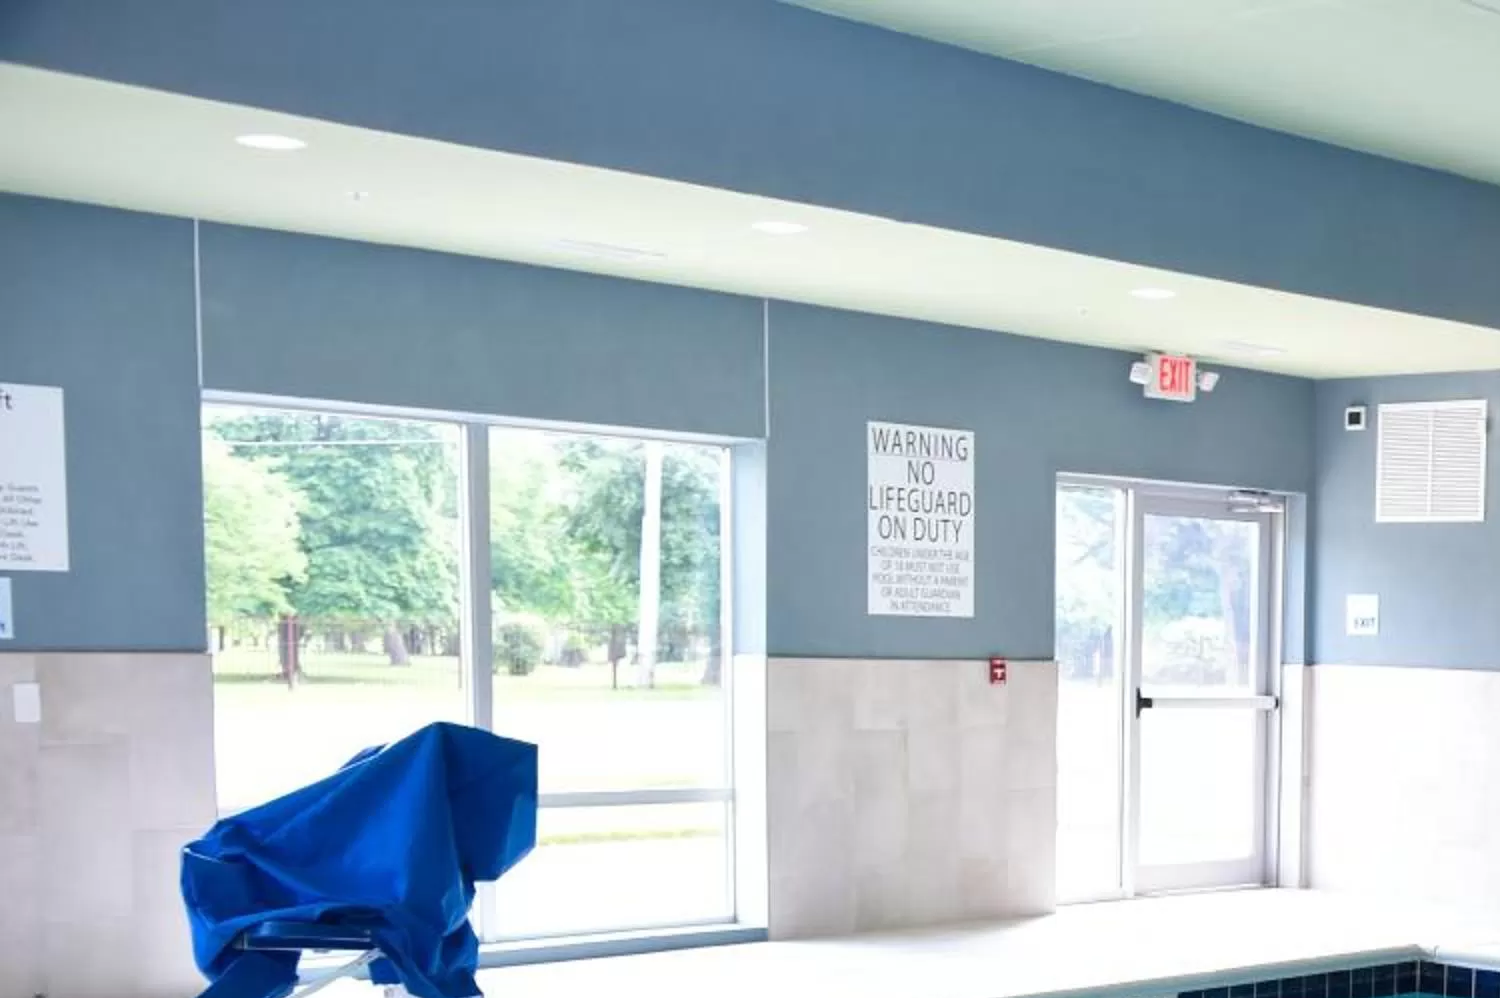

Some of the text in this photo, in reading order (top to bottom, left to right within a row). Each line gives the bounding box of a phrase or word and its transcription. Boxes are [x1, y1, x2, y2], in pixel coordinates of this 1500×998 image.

[1160, 358, 1191, 393] EXIT
[872, 427, 969, 461] WARNING
[907, 460, 935, 485] NO
[869, 485, 971, 516] LIFEGUARD
[878, 515, 963, 543] ON DUTY
[1353, 616, 1377, 629] EXIT
